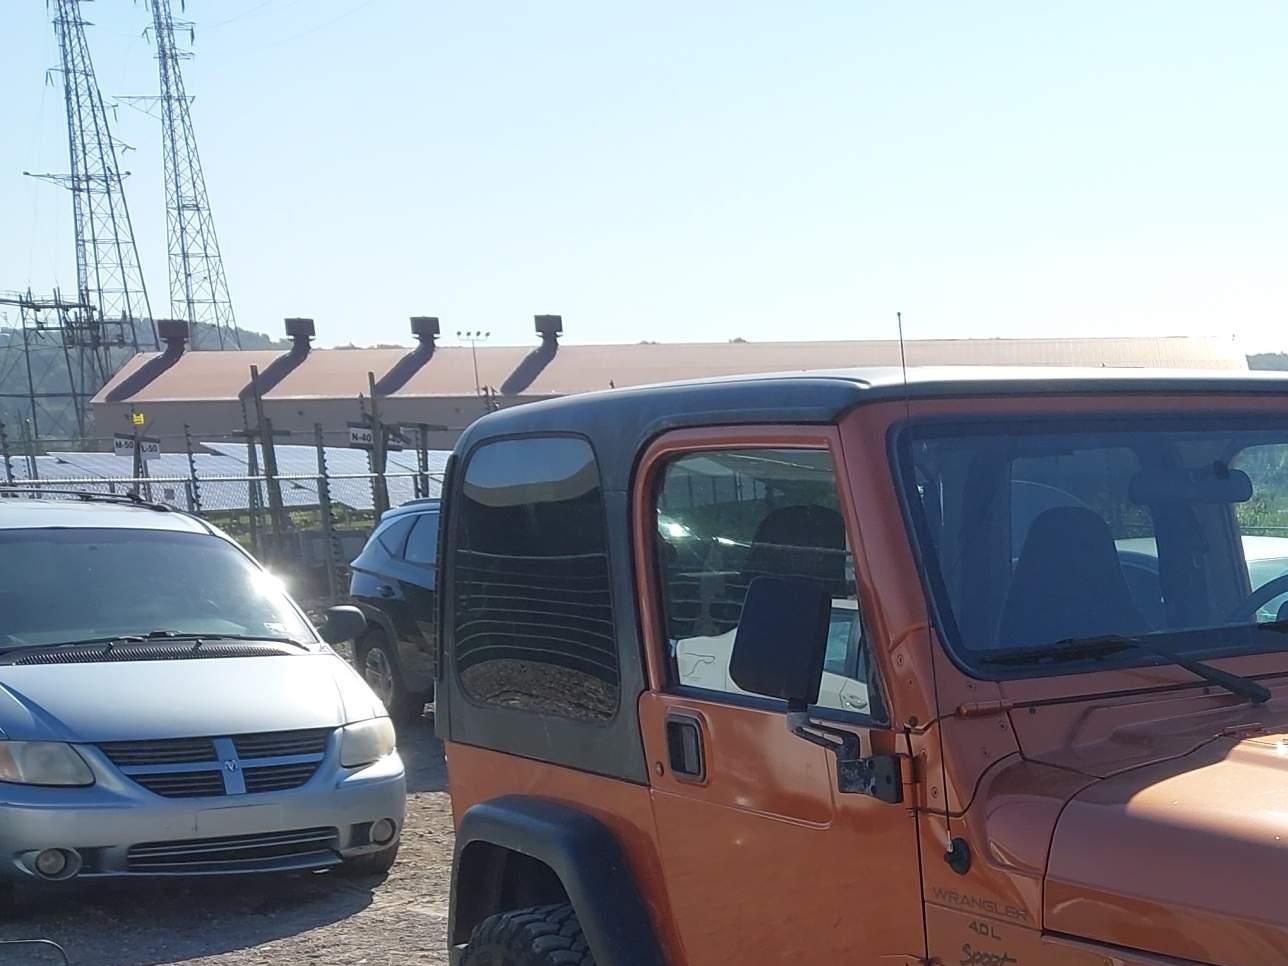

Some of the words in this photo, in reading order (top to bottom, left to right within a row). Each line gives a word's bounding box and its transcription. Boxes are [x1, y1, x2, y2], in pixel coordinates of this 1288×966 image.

[351, 432, 372, 442] N-40
[115, 440, 135, 449] M-50
[931, 887, 1028, 921] WRANGLER
